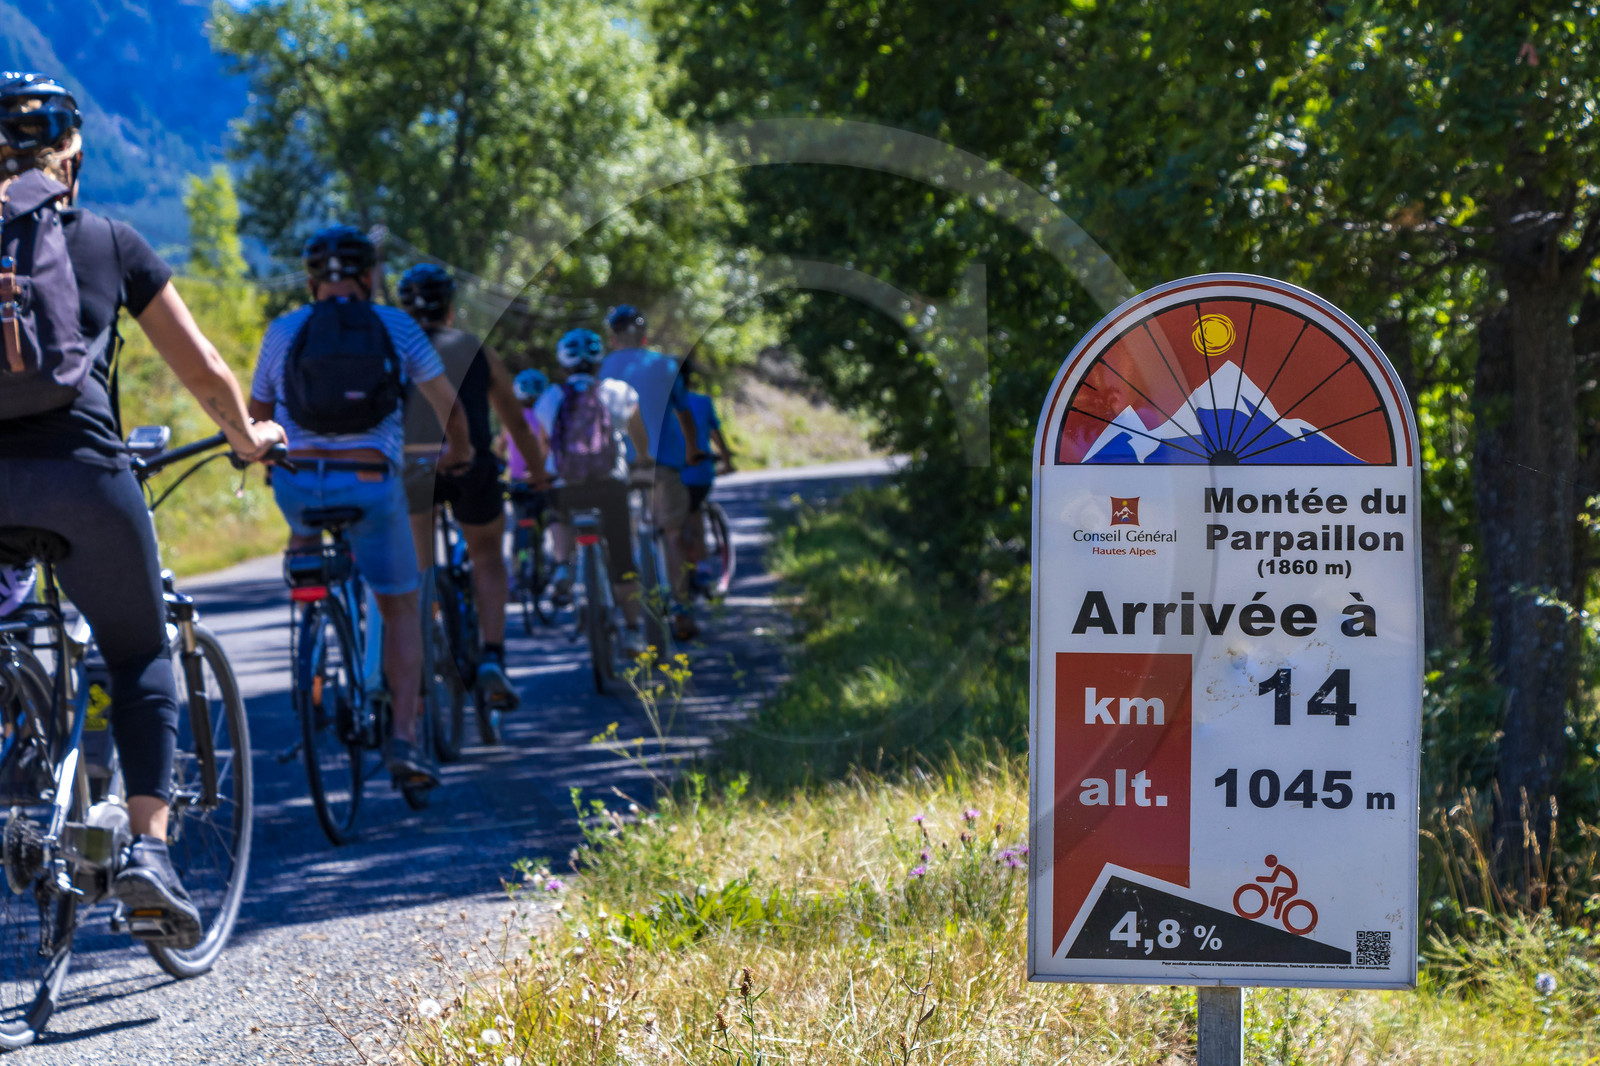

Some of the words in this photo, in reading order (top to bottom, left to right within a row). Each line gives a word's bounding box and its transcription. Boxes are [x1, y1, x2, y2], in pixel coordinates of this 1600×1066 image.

[1204, 487, 1348, 514] Montée
[1360, 488, 1407, 514] du
[1073, 529, 1121, 543] Conseil
[1126, 529, 1177, 543] Général
[1092, 547, 1127, 556] Hautes
[1129, 547, 1157, 557] Alpes
[1206, 524, 1405, 557] Parpaillon
[1257, 560, 1318, 578] (1860
[1325, 560, 1352, 578] m)
[1071, 591, 1318, 636] Arrivée
[1340, 592, 1378, 637] à
[1084, 687, 1165, 725] km
[1258, 668, 1357, 726] 14
[1079, 769, 1168, 806] alt.
[1214, 768, 1353, 809] 1045
[1366, 791, 1396, 810] m
[1109, 911, 1181, 955] 4,8
[1193, 925, 1223, 951] %
